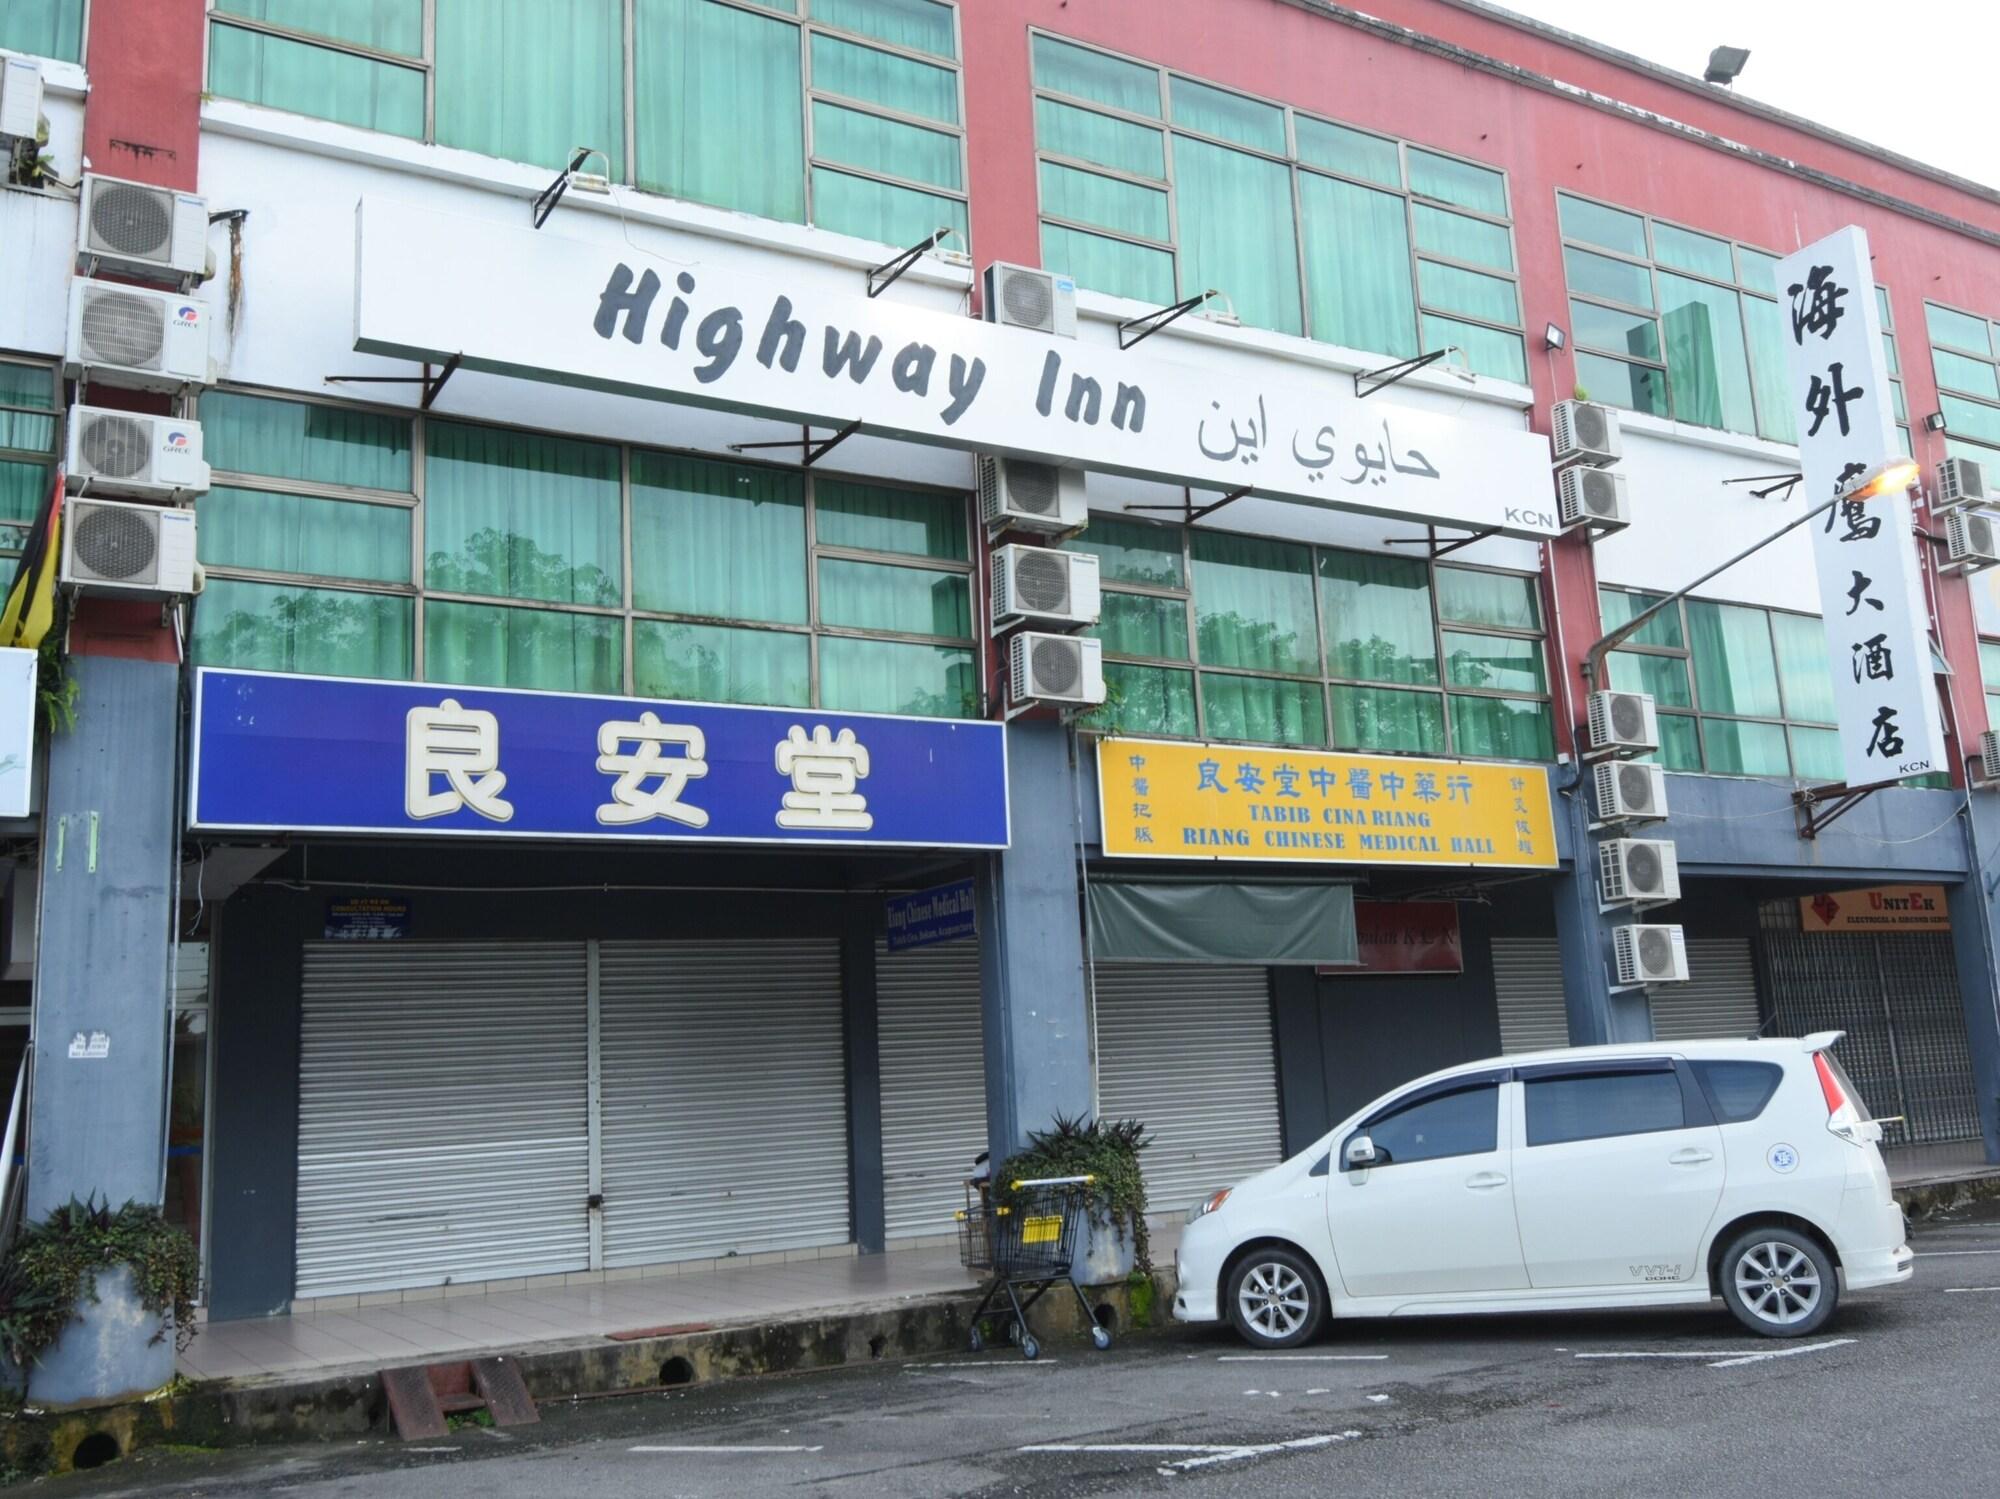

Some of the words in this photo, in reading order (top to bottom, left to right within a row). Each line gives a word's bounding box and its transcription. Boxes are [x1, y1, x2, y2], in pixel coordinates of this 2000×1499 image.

[593, 262, 986, 426] Highway
[1035, 349, 1146, 433] Inn
[1198, 393, 1268, 465] اين
[1504, 506, 1554, 529] KCN
[405, 698, 874, 831] 良安堂
[1899, 759, 1930, 773] KCN
[1248, 804, 1311, 824] TABIB
[1322, 807, 1367, 825] CINA
[1372, 810, 1432, 828] RIANG
[1182, 827, 1250, 846] RIANG
[1264, 830, 1346, 850] CHINESE
[1359, 832, 1441, 853] MEDICAL
[1450, 837, 1495, 854] HALL
[907, 899, 933, 925] Chinese
[932, 889, 960, 920] Medical
[959, 887, 975, 912] Hall
[1847, 916, 1889, 924] ELECTRICAL
